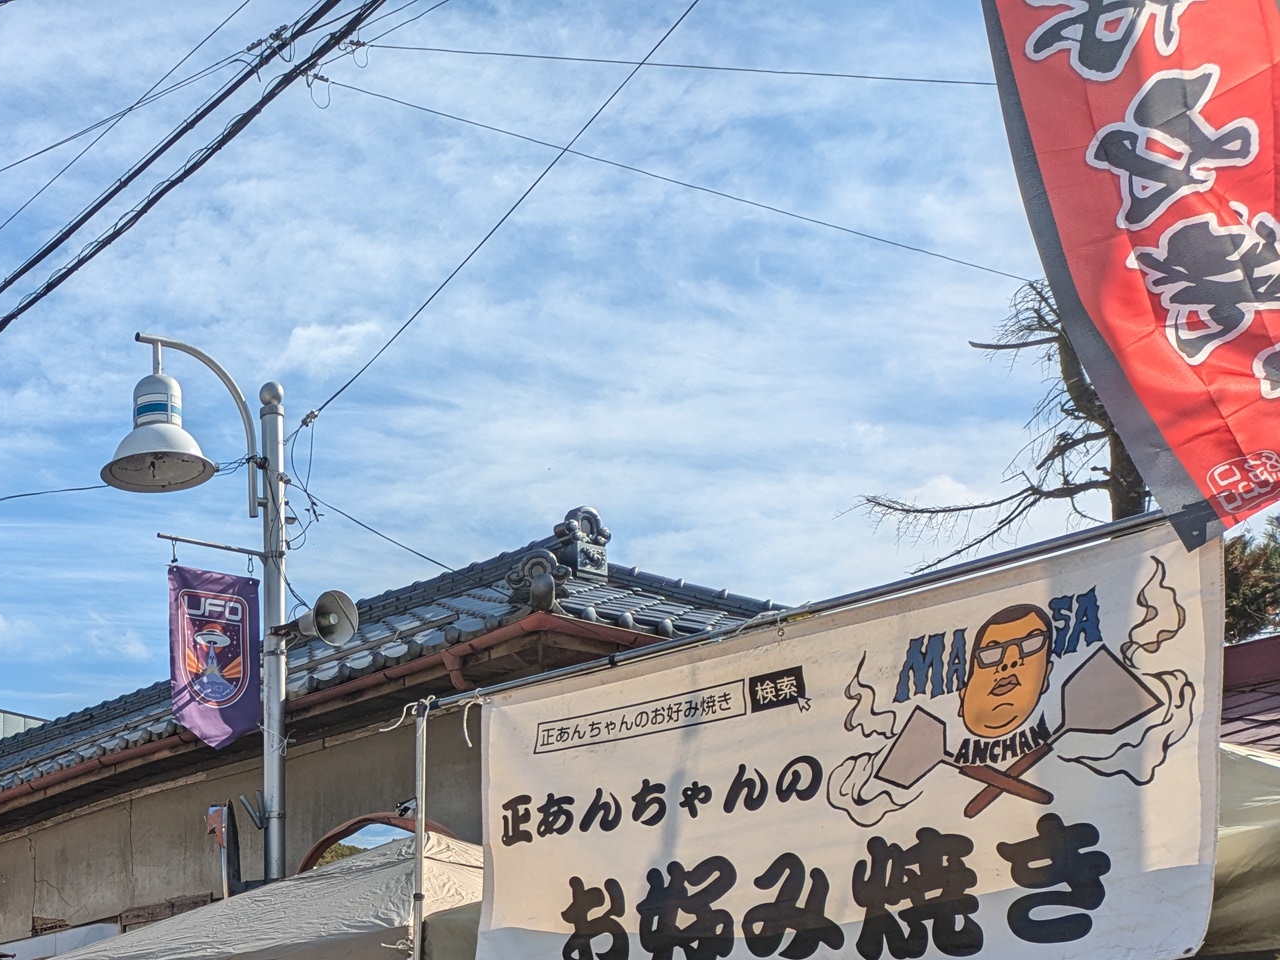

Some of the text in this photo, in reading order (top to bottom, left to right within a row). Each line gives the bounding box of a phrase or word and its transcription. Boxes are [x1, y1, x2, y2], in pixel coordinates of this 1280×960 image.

[184, 596, 242, 621] UFO
[755, 676, 799, 705] 検索
[539, 691, 733, 748] 正あんちゃんのお好み焼き
[954, 710, 1053, 765] ANCHAN
[501, 755, 823, 847] 正あんちゃんの
